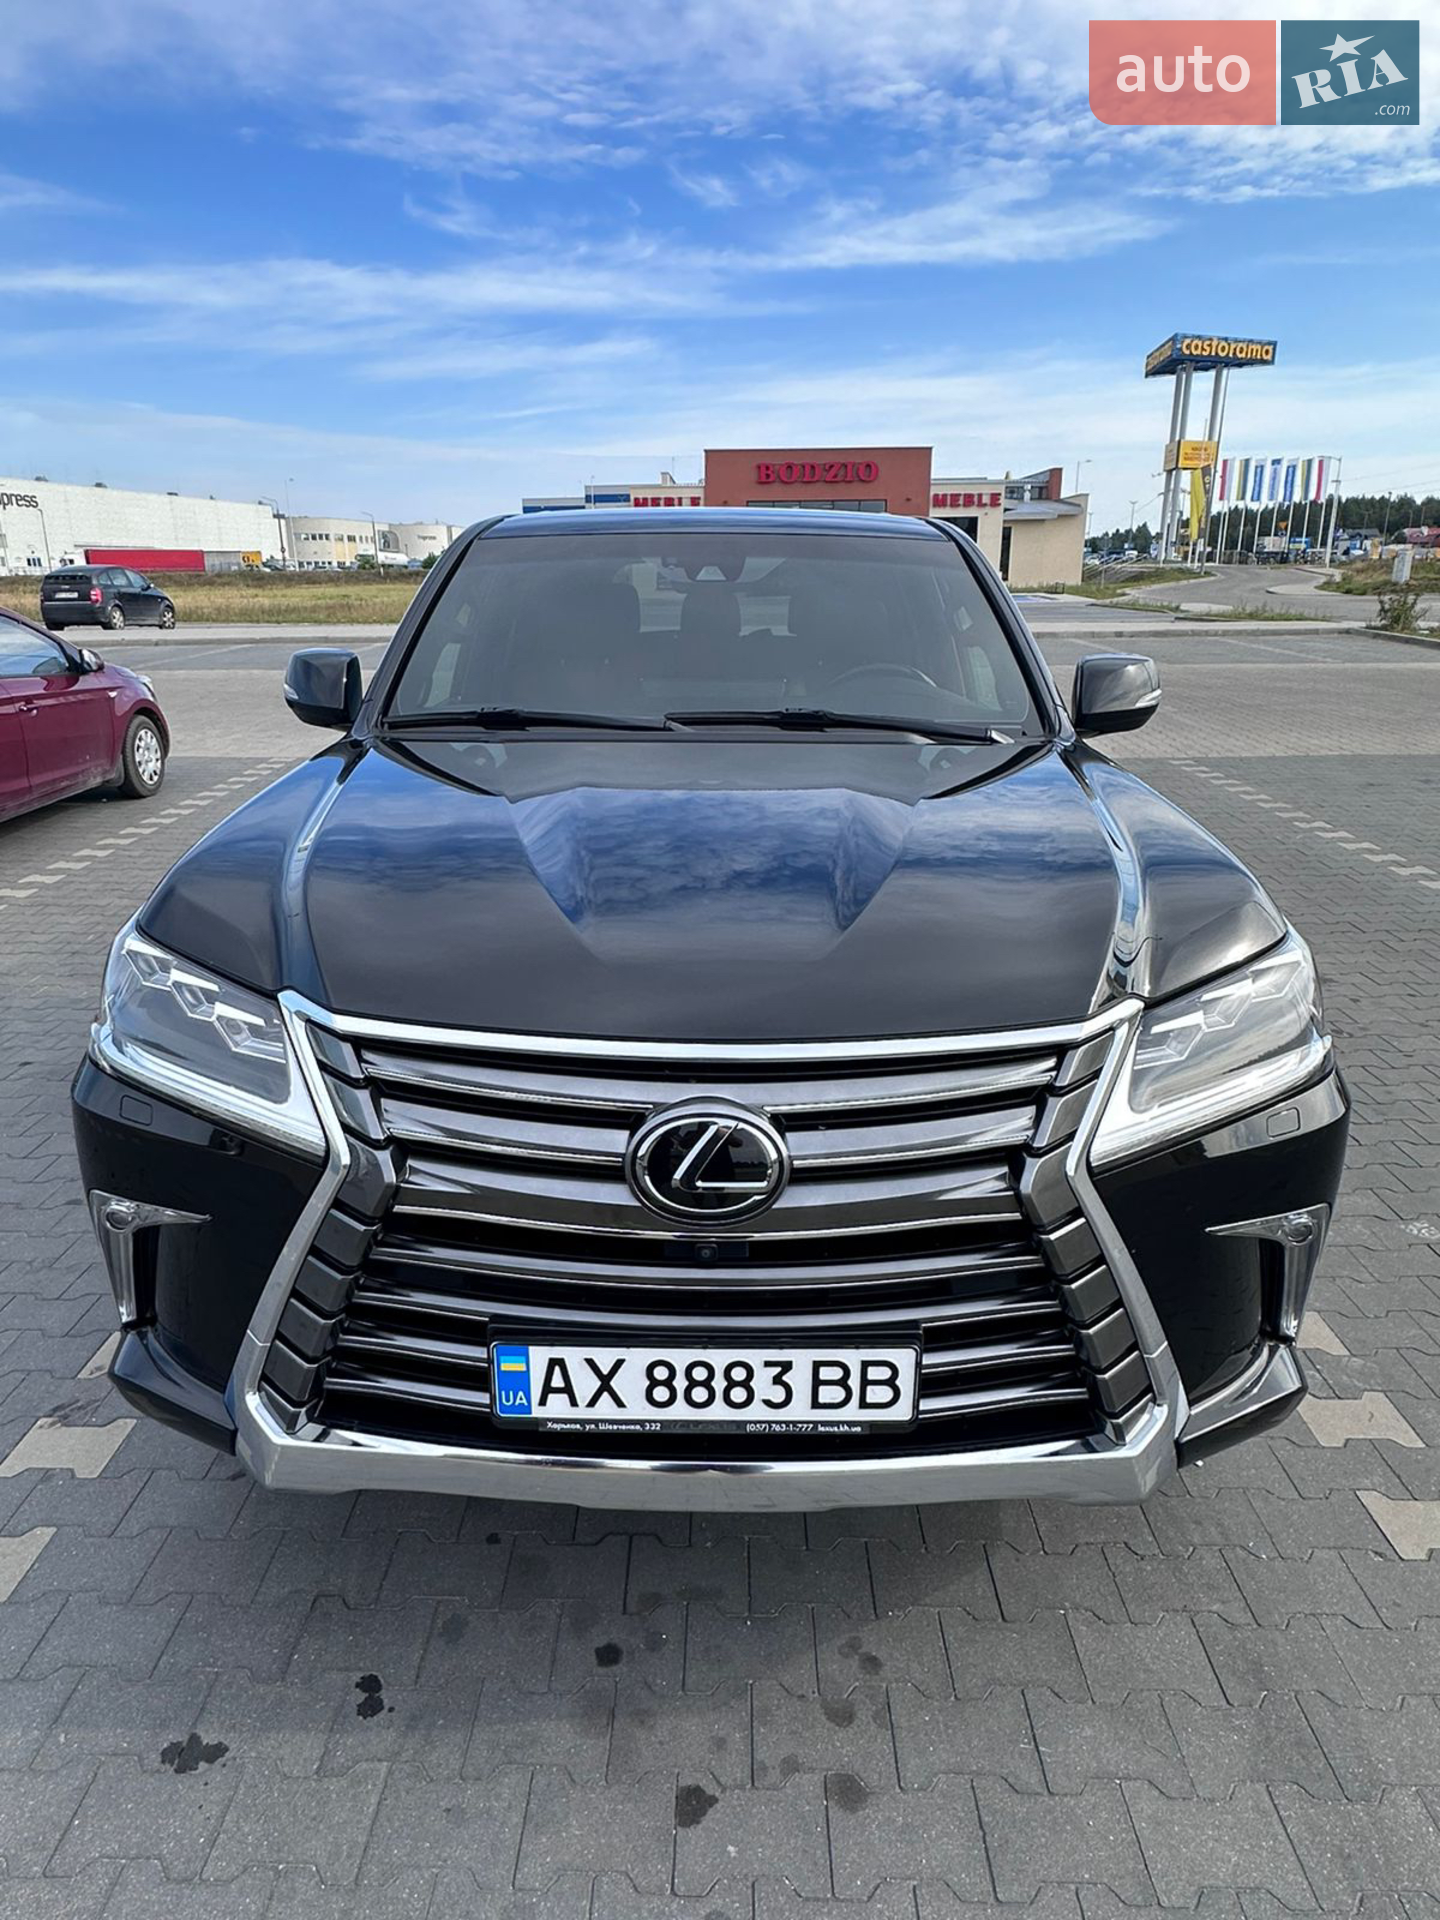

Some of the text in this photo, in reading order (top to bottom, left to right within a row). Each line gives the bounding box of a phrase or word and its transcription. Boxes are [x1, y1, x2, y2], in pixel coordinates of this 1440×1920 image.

[1182, 337, 1274, 360] castorama
[756, 460, 880, 485] BODZIO
[0, 492, 39, 510] press
[932, 492, 1002, 508] MEBLE
[537, 1356, 902, 1411] AX 8883 BB
[501, 1390, 528, 1406] UA
[644, 1422, 661, 1431] 332
[746, 1421, 769, 1433] (057)
